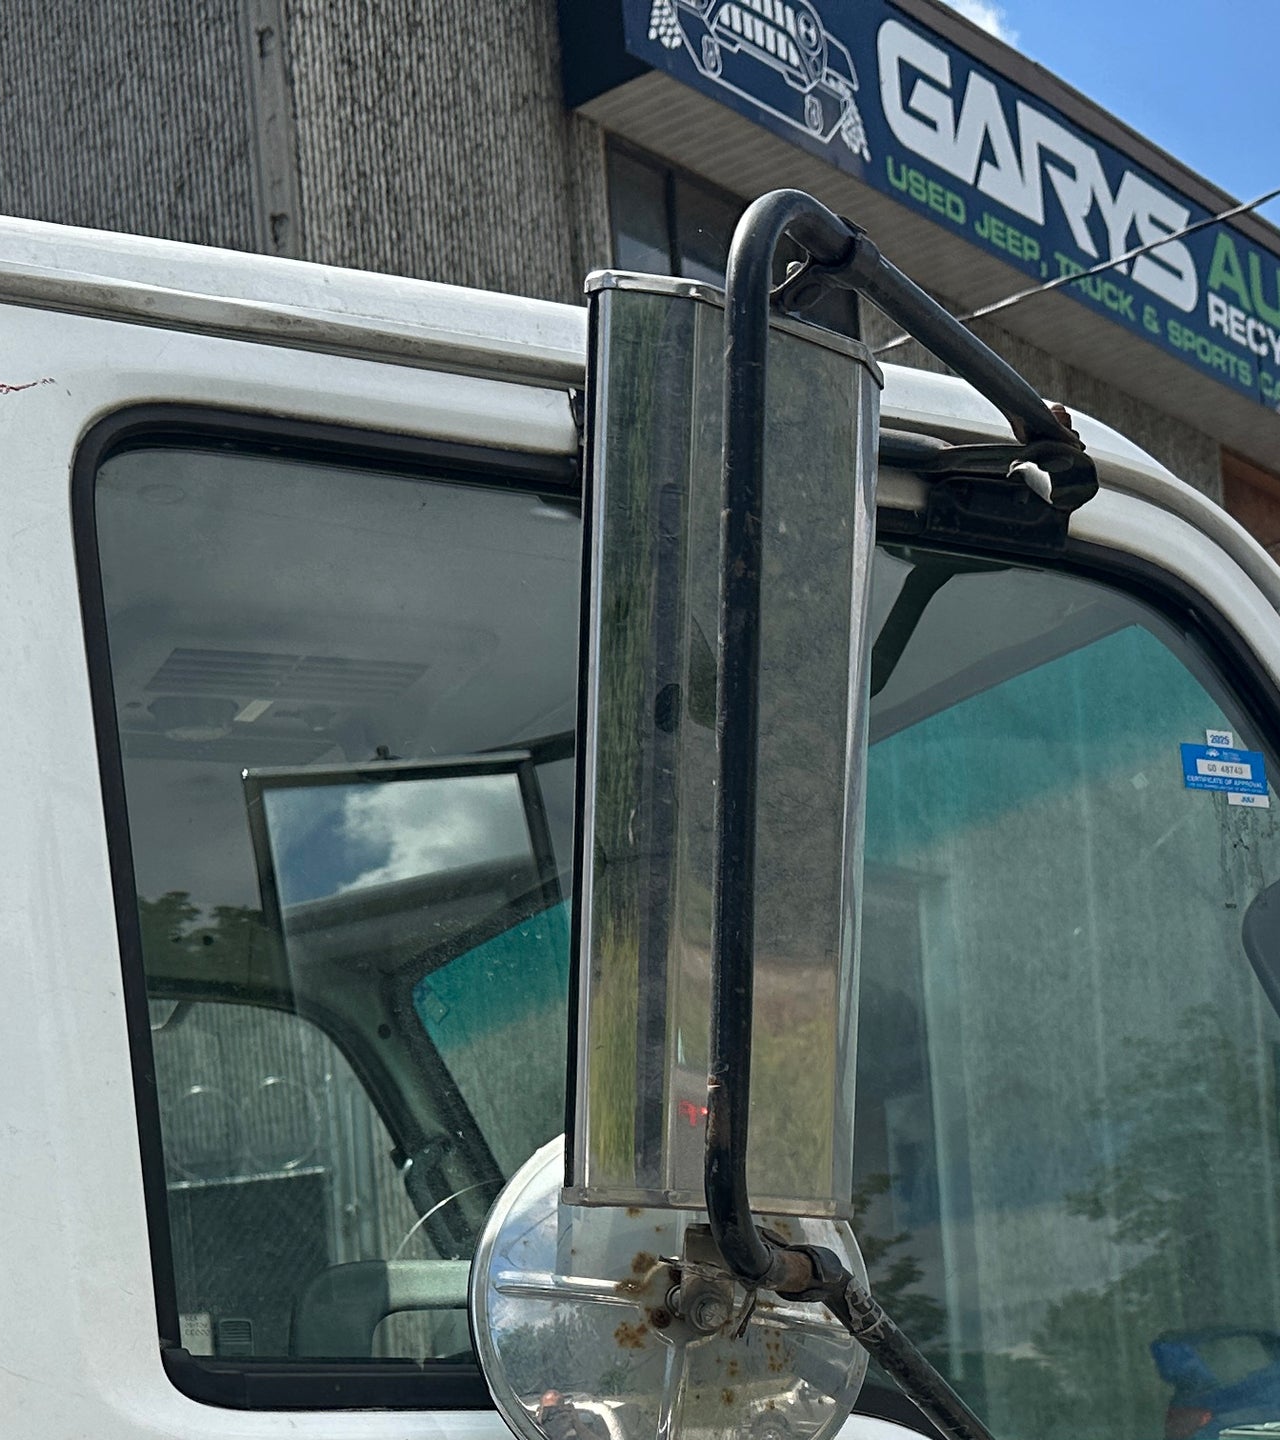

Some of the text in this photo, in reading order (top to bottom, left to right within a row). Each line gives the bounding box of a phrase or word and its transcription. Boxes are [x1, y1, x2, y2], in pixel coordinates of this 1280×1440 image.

[877, 18, 1198, 313] GARYS
[886, 155, 967, 225] USED
[974, 211, 1048, 278] JEEP,
[1053, 251, 1136, 321] TRUCK
[1142, 304, 1160, 335] &
[1167, 319, 1252, 387] SPORTS
